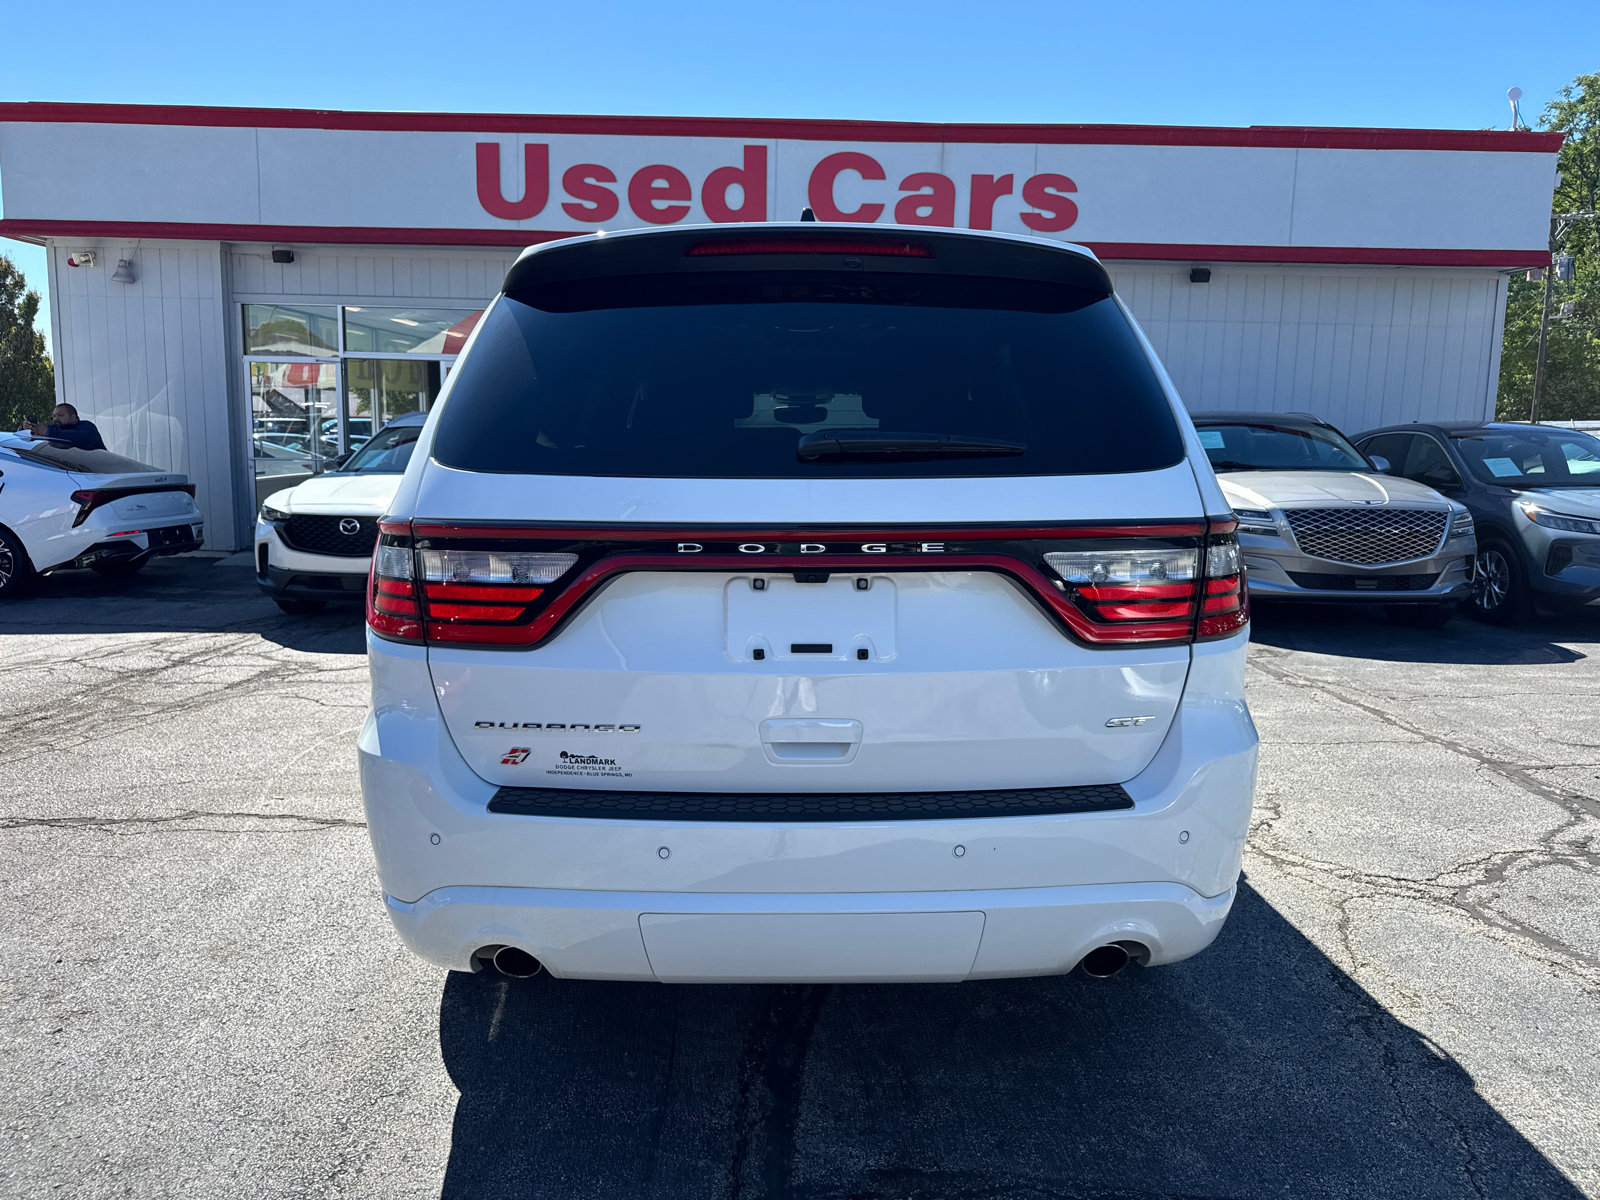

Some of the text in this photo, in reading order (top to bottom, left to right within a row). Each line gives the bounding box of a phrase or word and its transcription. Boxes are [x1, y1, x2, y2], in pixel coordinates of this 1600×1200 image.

[475, 142, 1079, 233] Used Cars
[677, 542, 945, 554] DODGE
[474, 721, 641, 734] DURANGO
[1104, 715, 1156, 728] GT
